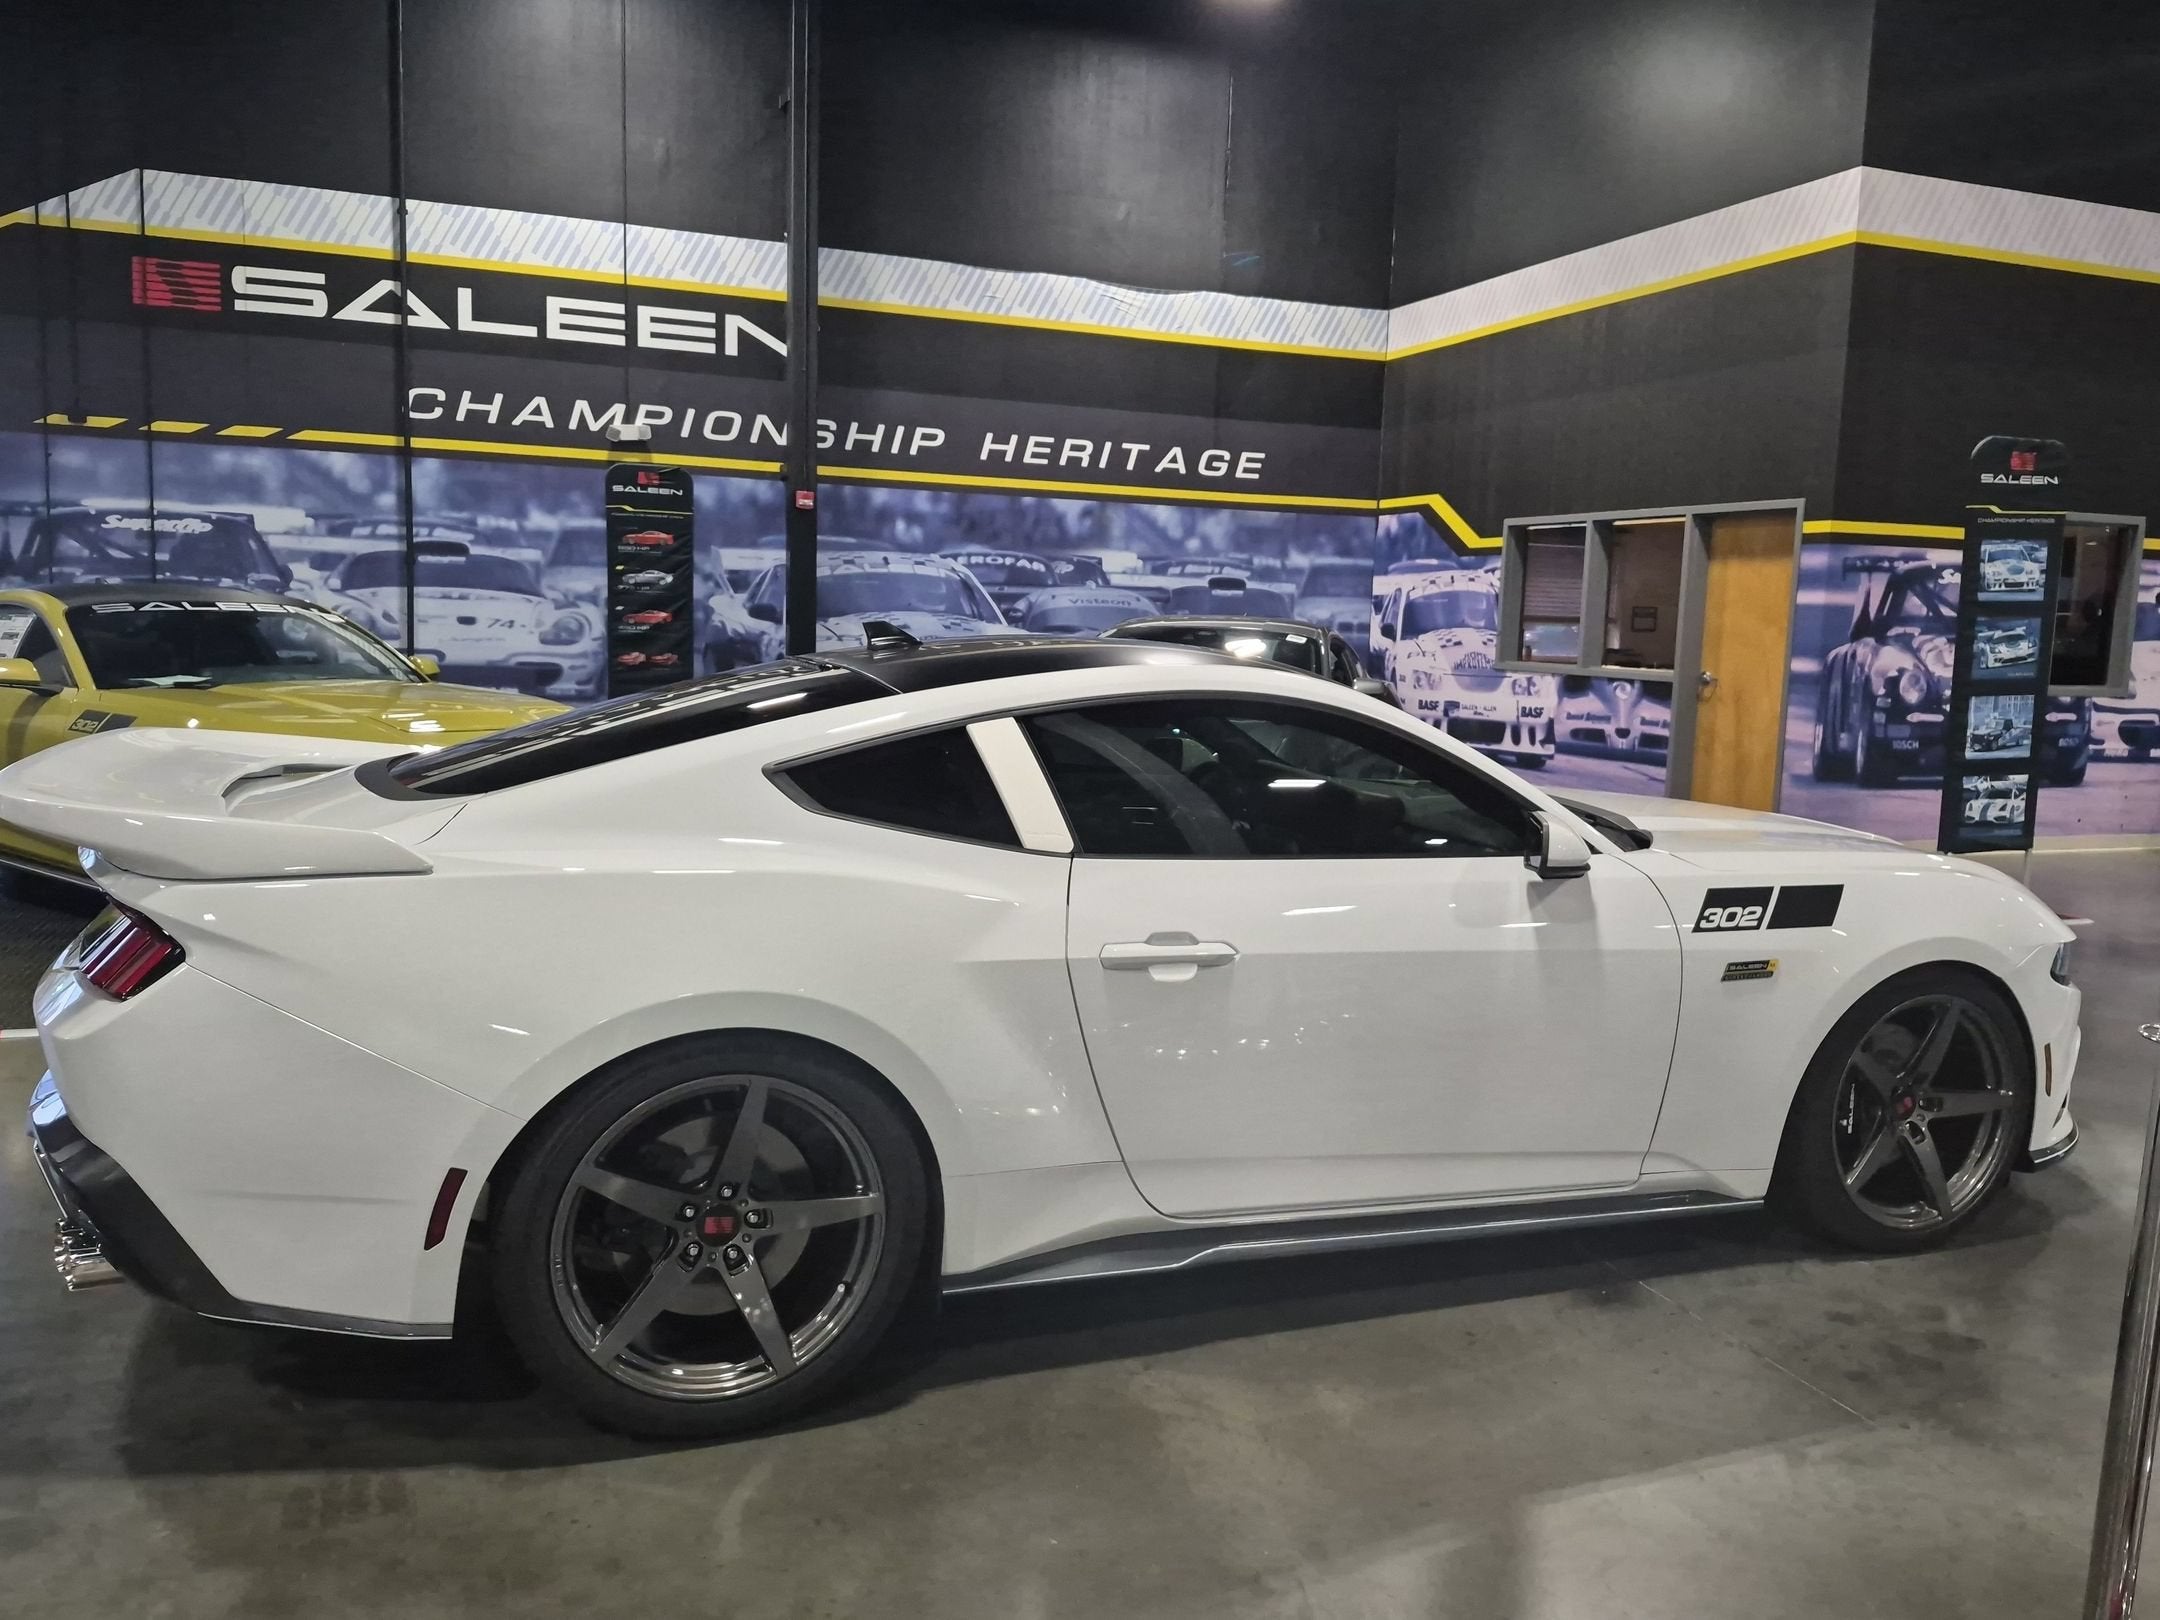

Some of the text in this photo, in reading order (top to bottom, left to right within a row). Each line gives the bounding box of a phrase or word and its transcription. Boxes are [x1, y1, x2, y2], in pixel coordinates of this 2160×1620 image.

[230, 265, 788, 356] SALEEN
[408, 387, 1266, 479] CHAMPIONSHIP HERITAGE
[1980, 472, 2059, 485] SALEEN
[611, 484, 684, 496] SALEEN
[1418, 699, 1440, 711] BASF
[1520, 706, 1545, 719] BASF
[71, 719, 99, 731] 302
[1699, 906, 1763, 929] 302
